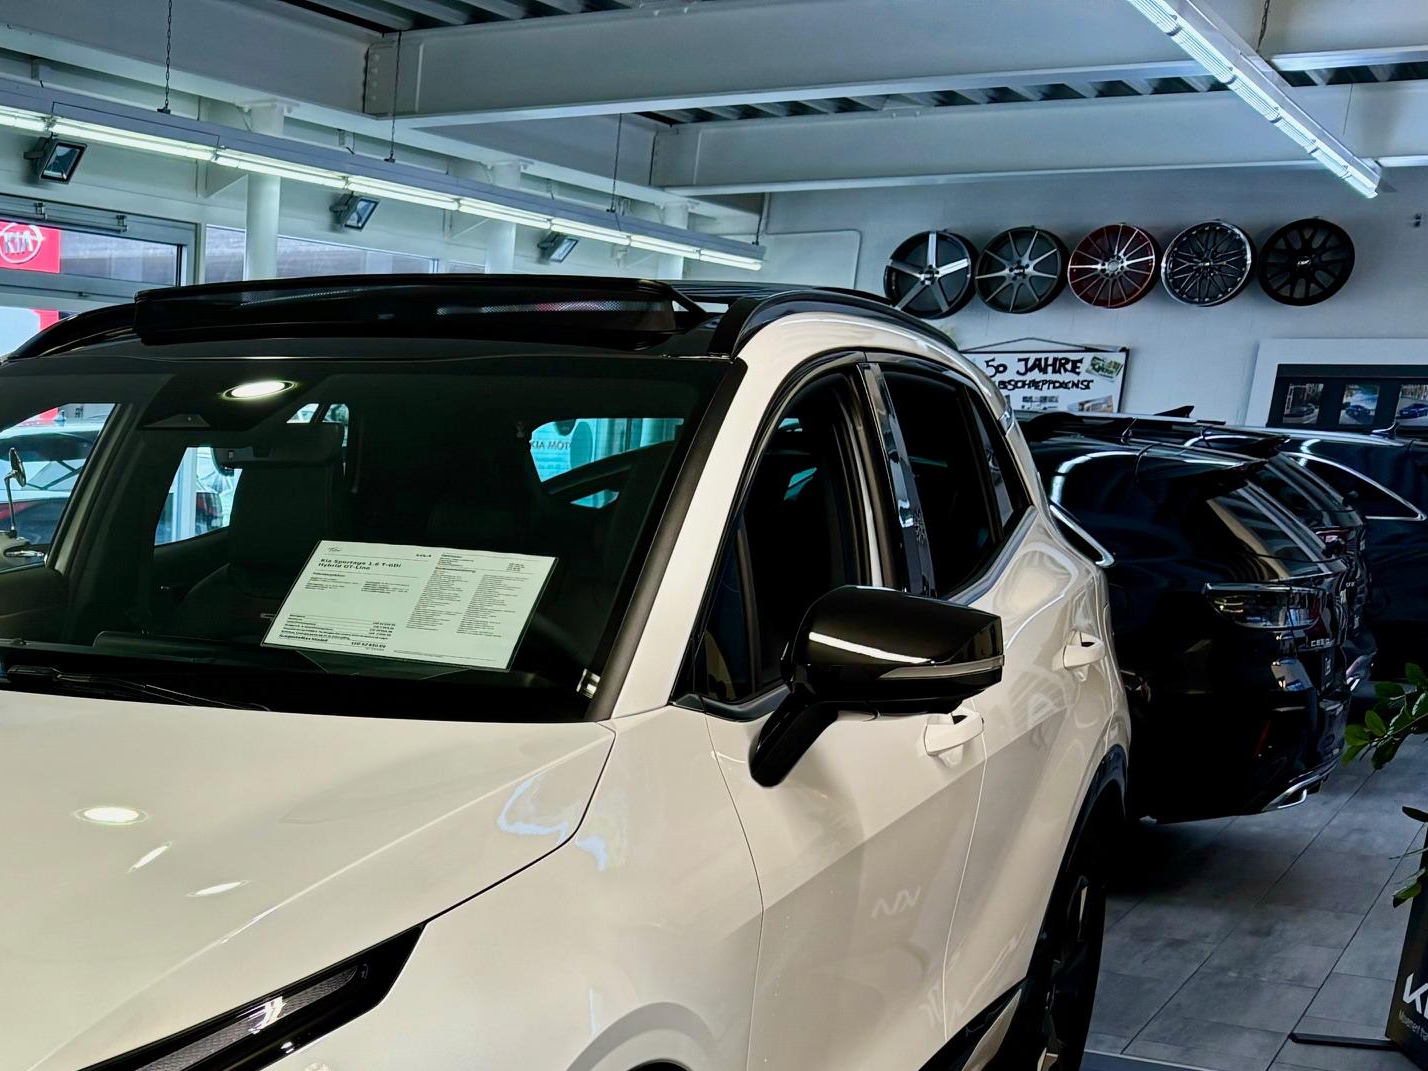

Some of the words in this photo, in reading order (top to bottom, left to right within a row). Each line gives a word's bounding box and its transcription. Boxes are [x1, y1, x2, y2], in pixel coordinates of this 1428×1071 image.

[3, 229, 34, 254] KIA
[985, 357, 1009, 378] 50
[1016, 356, 1085, 376] JAHRE
[995, 378, 1094, 391] BSCHLEPPDIENST
[1403, 972, 1428, 1020] K
